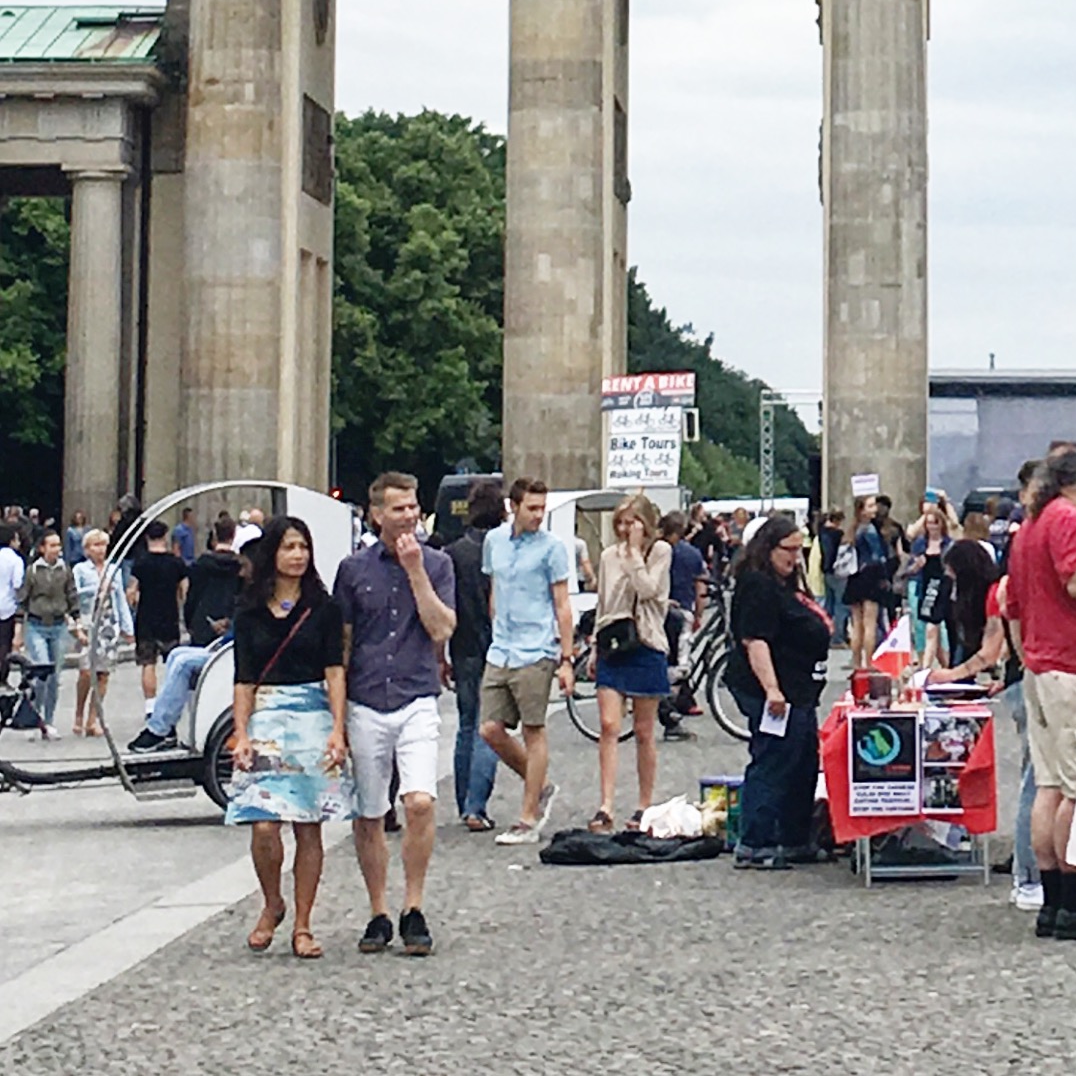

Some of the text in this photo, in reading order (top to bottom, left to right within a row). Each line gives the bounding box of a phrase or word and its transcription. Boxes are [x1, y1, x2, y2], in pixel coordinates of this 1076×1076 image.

[602, 377, 642, 393] RENT
[643, 375, 655, 390] A
[658, 373, 695, 389] BIKE
[610, 436, 676, 451] Bike Tours
